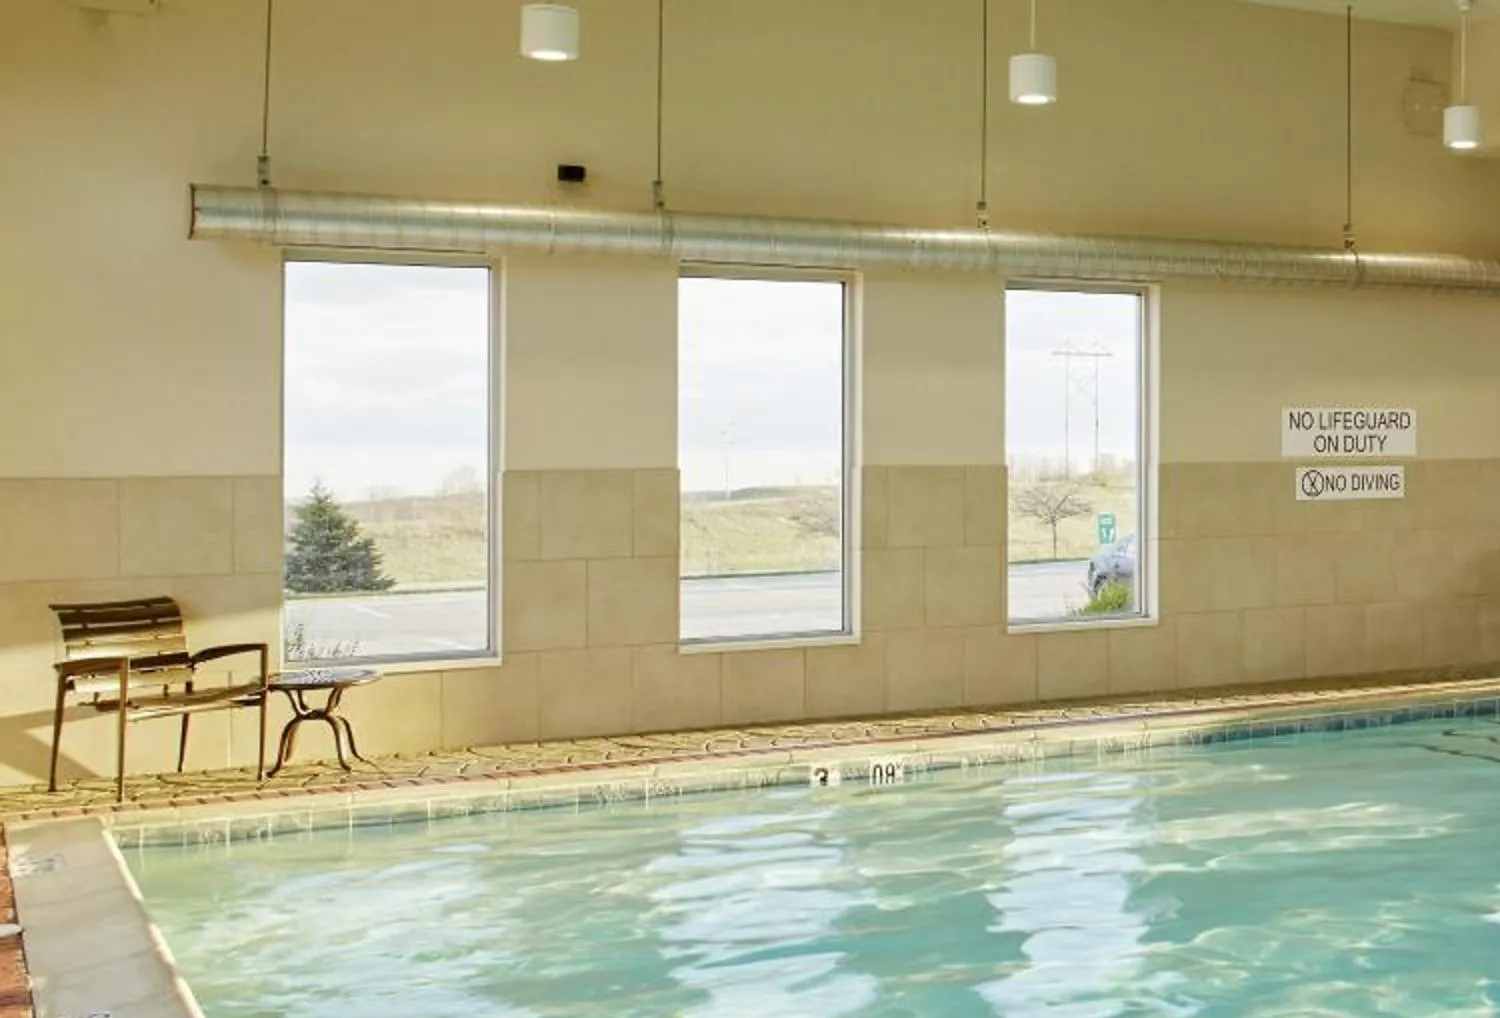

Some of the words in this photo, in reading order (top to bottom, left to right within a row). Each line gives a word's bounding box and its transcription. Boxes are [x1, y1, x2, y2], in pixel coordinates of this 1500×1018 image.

[1289, 411, 1315, 430] NO
[1319, 411, 1411, 430] LIFEGUARD
[1313, 434, 1338, 452] ON
[1343, 434, 1387, 452] DUTY
[1325, 474, 1347, 492] NO
[1351, 473, 1400, 491] DIVING
